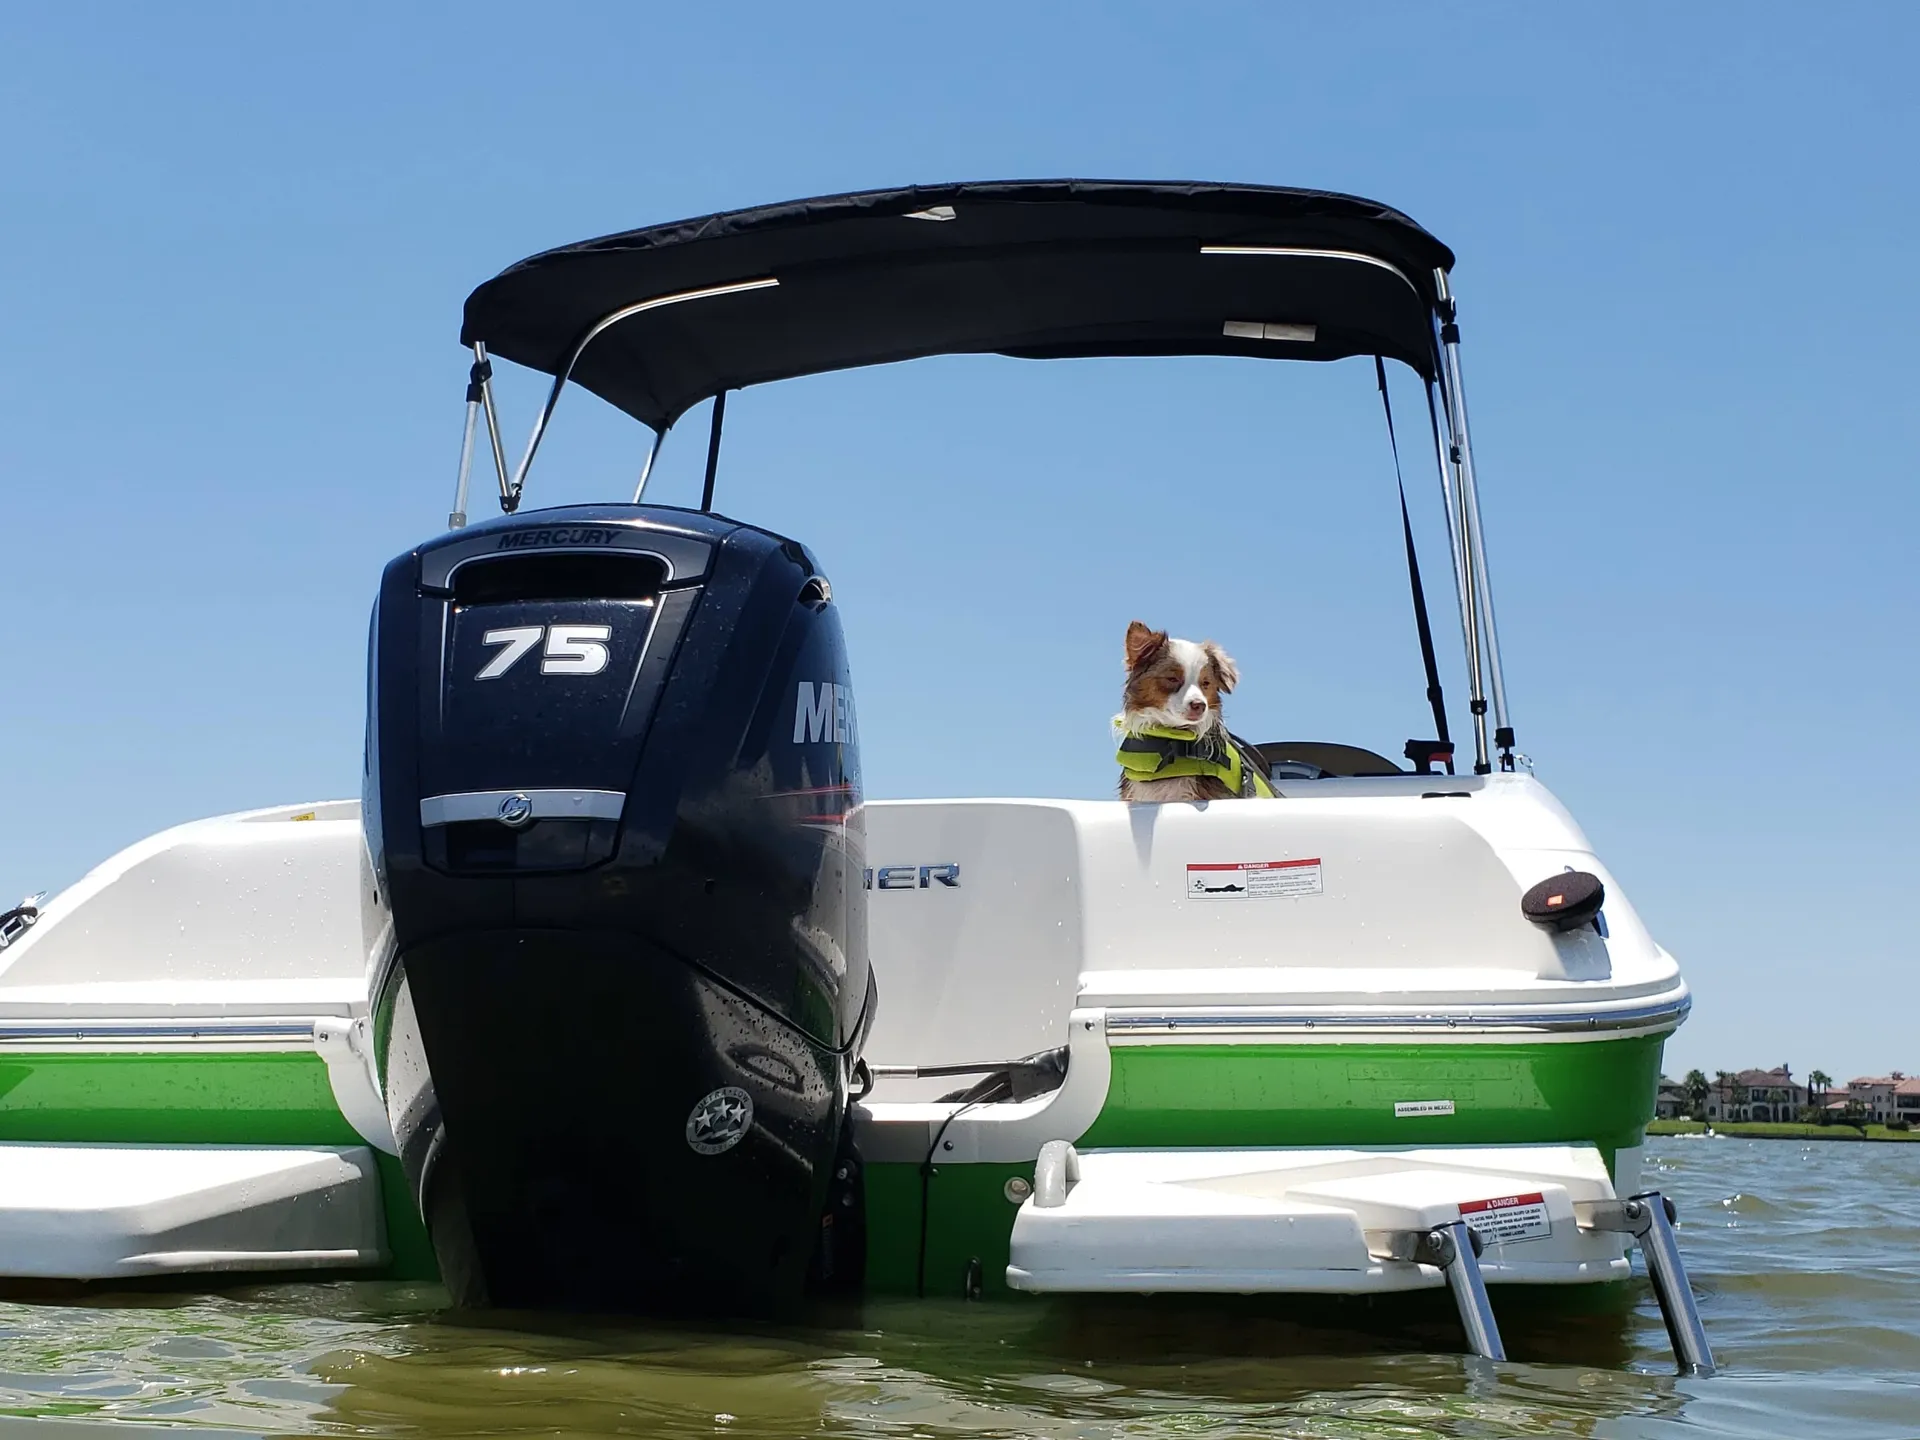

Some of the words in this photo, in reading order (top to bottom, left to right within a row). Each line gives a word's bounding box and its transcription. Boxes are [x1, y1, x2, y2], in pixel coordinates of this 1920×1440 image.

[497, 529, 622, 549] MERCURY
[474, 624, 612, 681] 75
[1492, 1197, 1519, 1208] DANGER
